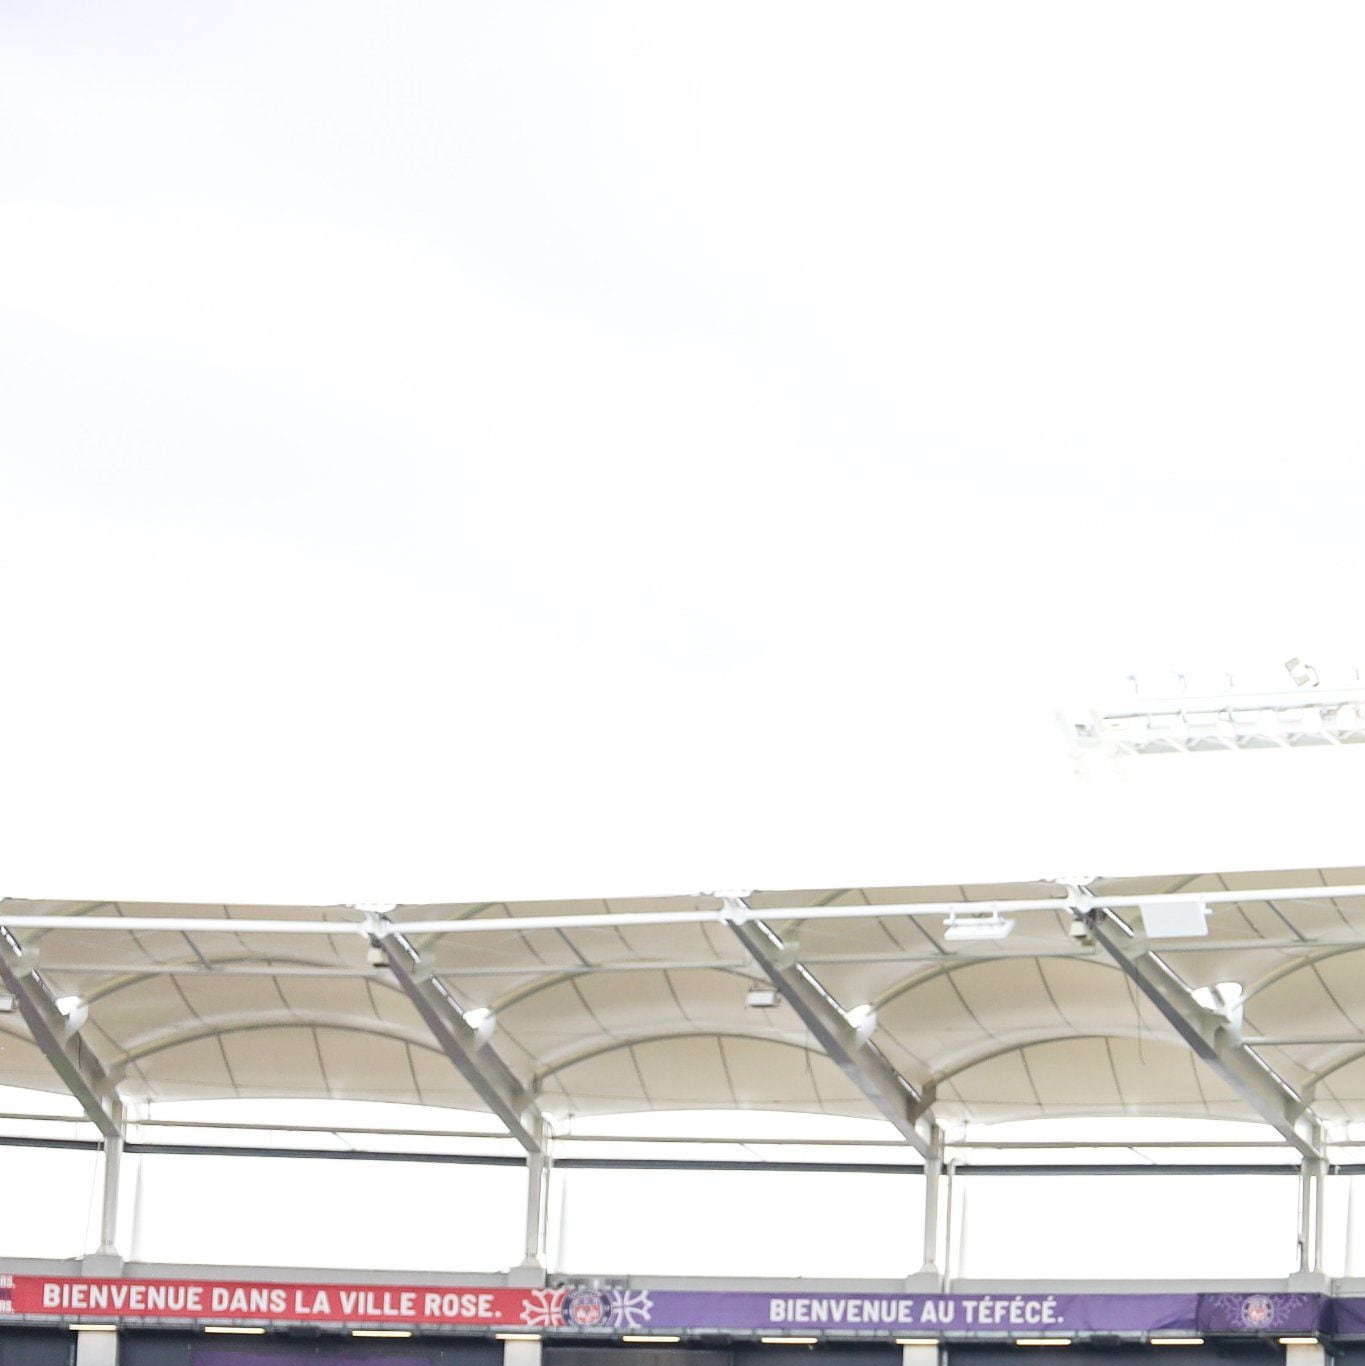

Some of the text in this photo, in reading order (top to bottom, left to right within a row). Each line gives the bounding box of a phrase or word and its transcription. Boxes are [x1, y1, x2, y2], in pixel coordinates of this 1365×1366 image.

[43, 1283, 203, 1312] BIENVENUE
[211, 1287, 287, 1313] DANS
[295, 1289, 331, 1314] LA
[340, 1291, 417, 1316] VILLE
[424, 1293, 502, 1318] ROSE.
[769, 1295, 1064, 1324] BIENVENUE AU TÉFÉCÉ.
